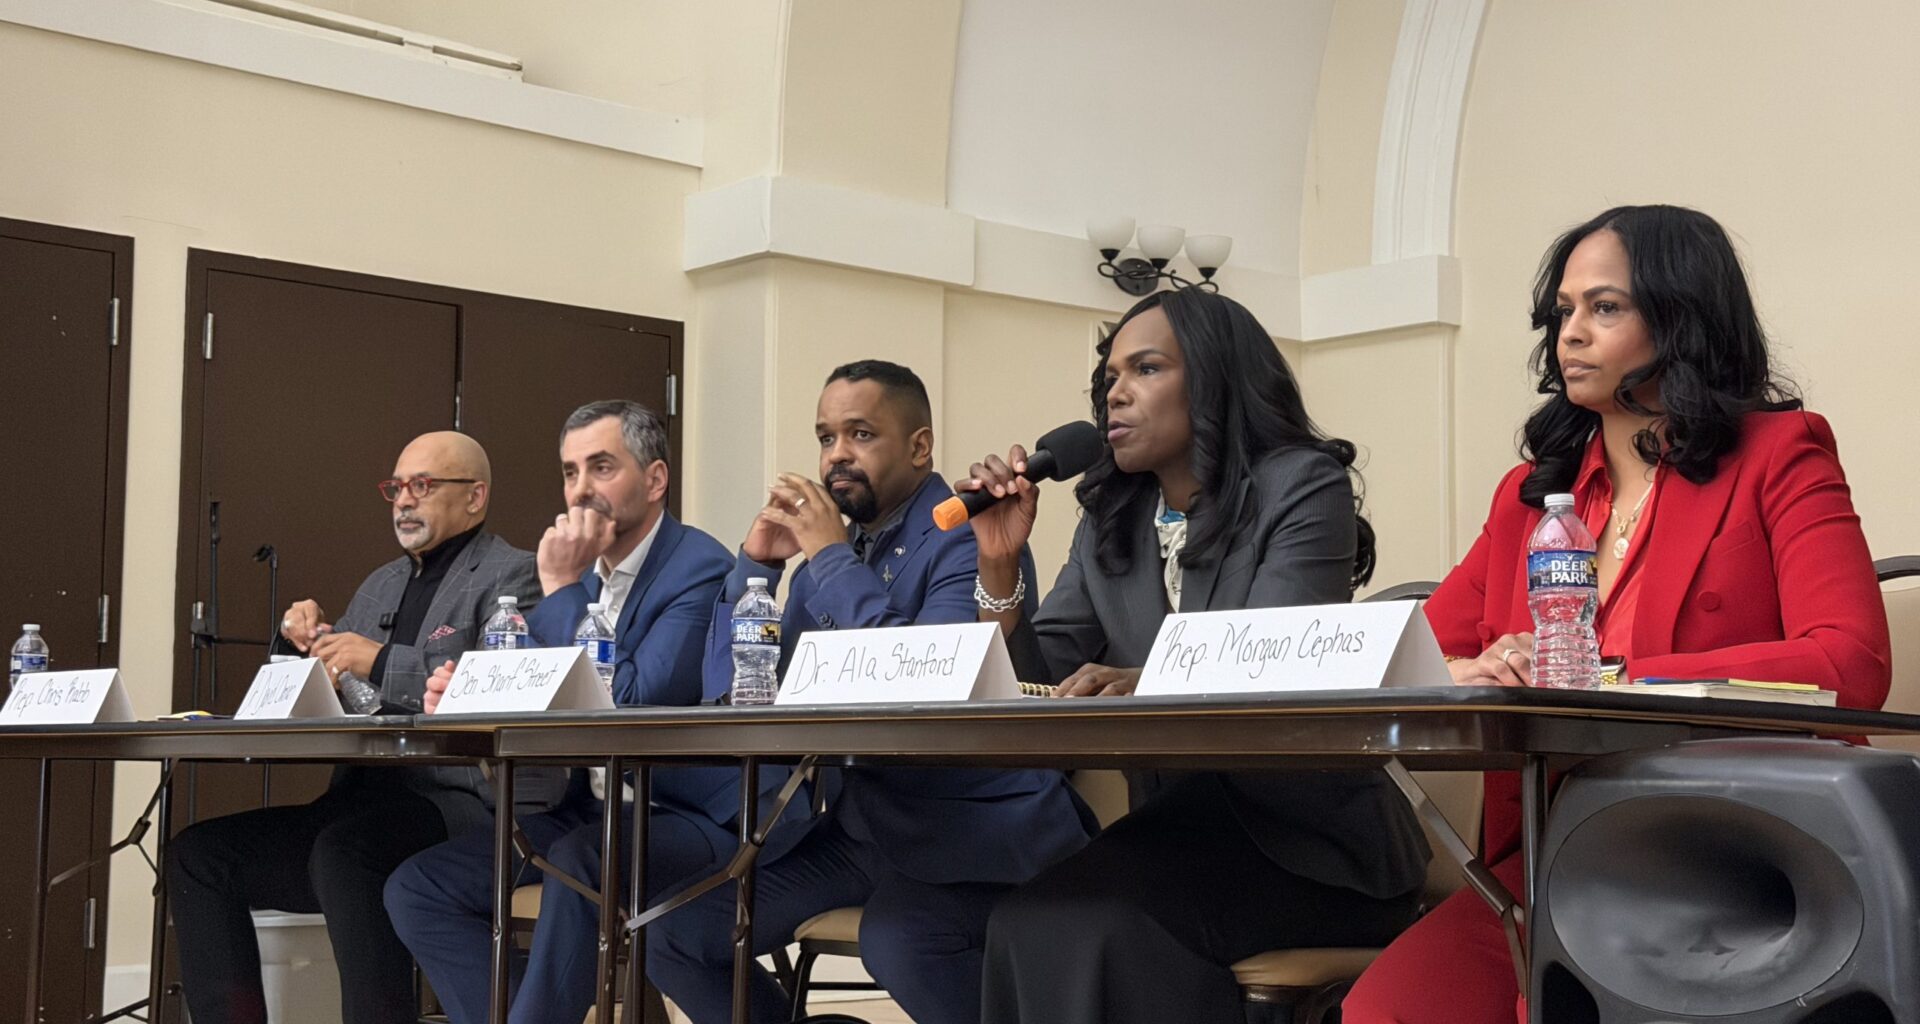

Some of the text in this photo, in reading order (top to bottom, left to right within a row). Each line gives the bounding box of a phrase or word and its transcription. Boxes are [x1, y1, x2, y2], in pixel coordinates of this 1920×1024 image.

[1551, 560, 1587, 571] DEER
[1551, 572, 1588, 584] PARK
[737, 624, 761, 634] DEER
[737, 634, 762, 642] PARK
[1159, 618, 1365, 682] Rep. Morgan Cephas
[790, 634, 962, 695] Dr. Ala Stanford
[517, 658, 558, 690] Street
